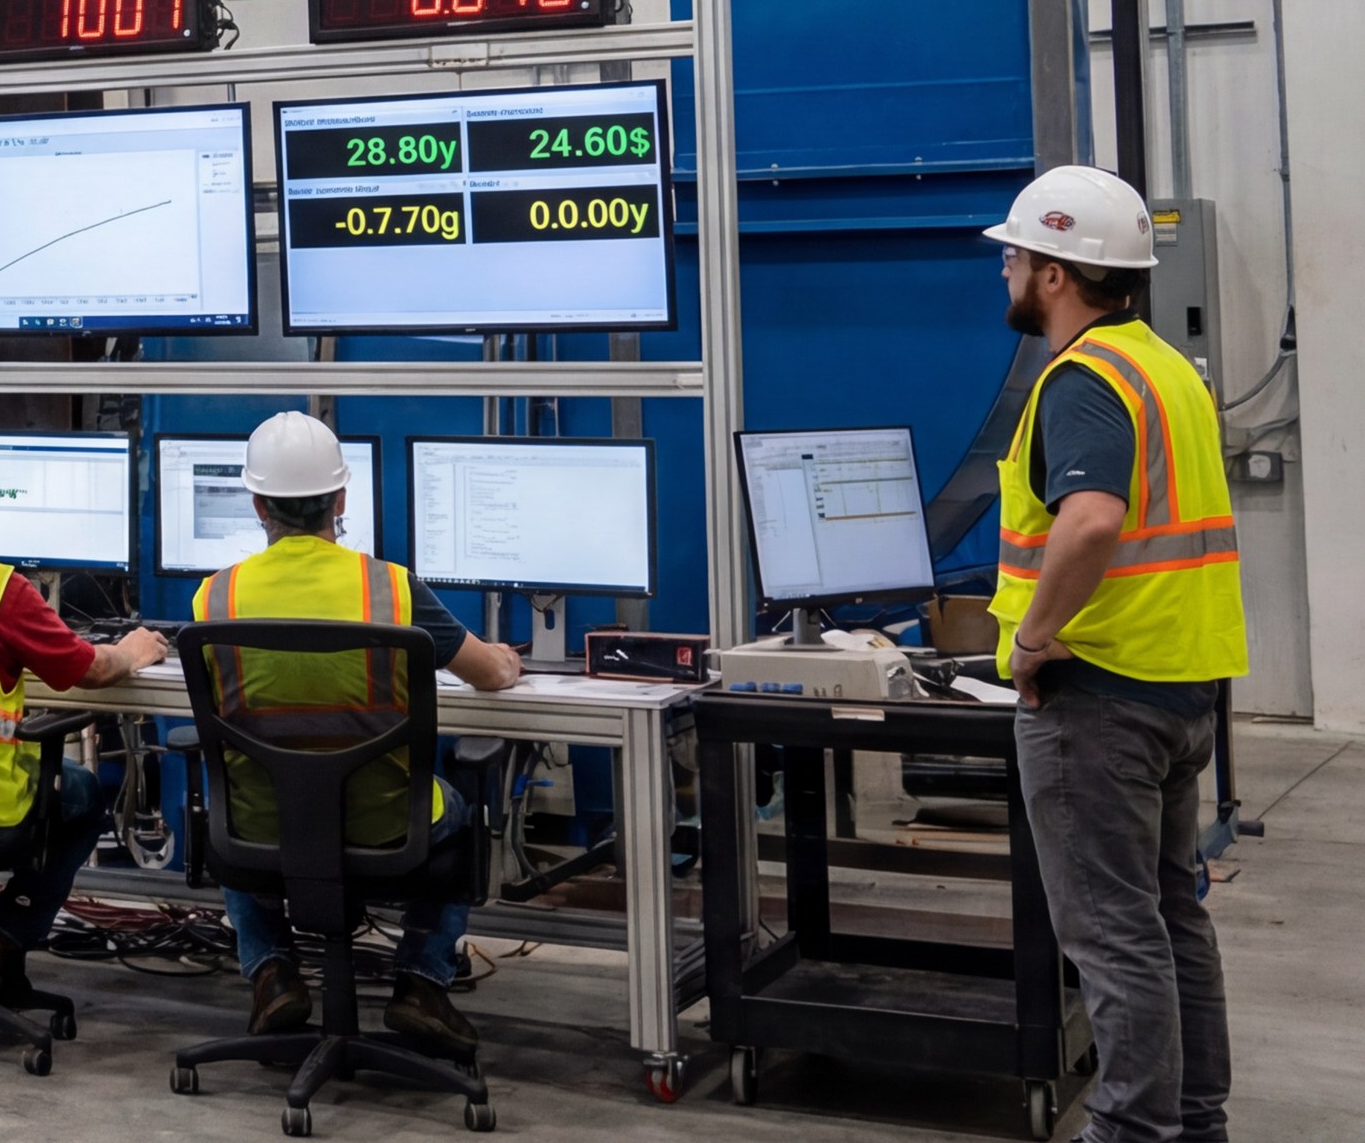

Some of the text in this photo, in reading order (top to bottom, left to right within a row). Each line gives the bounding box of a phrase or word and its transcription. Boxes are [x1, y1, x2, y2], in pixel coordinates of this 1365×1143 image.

[346, 134, 457, 170] 28.80y
[528, 124, 651, 158] 24.60$
[334, 204, 460, 241] -0.7.70g
[529, 197, 649, 234] 0.0.00y
